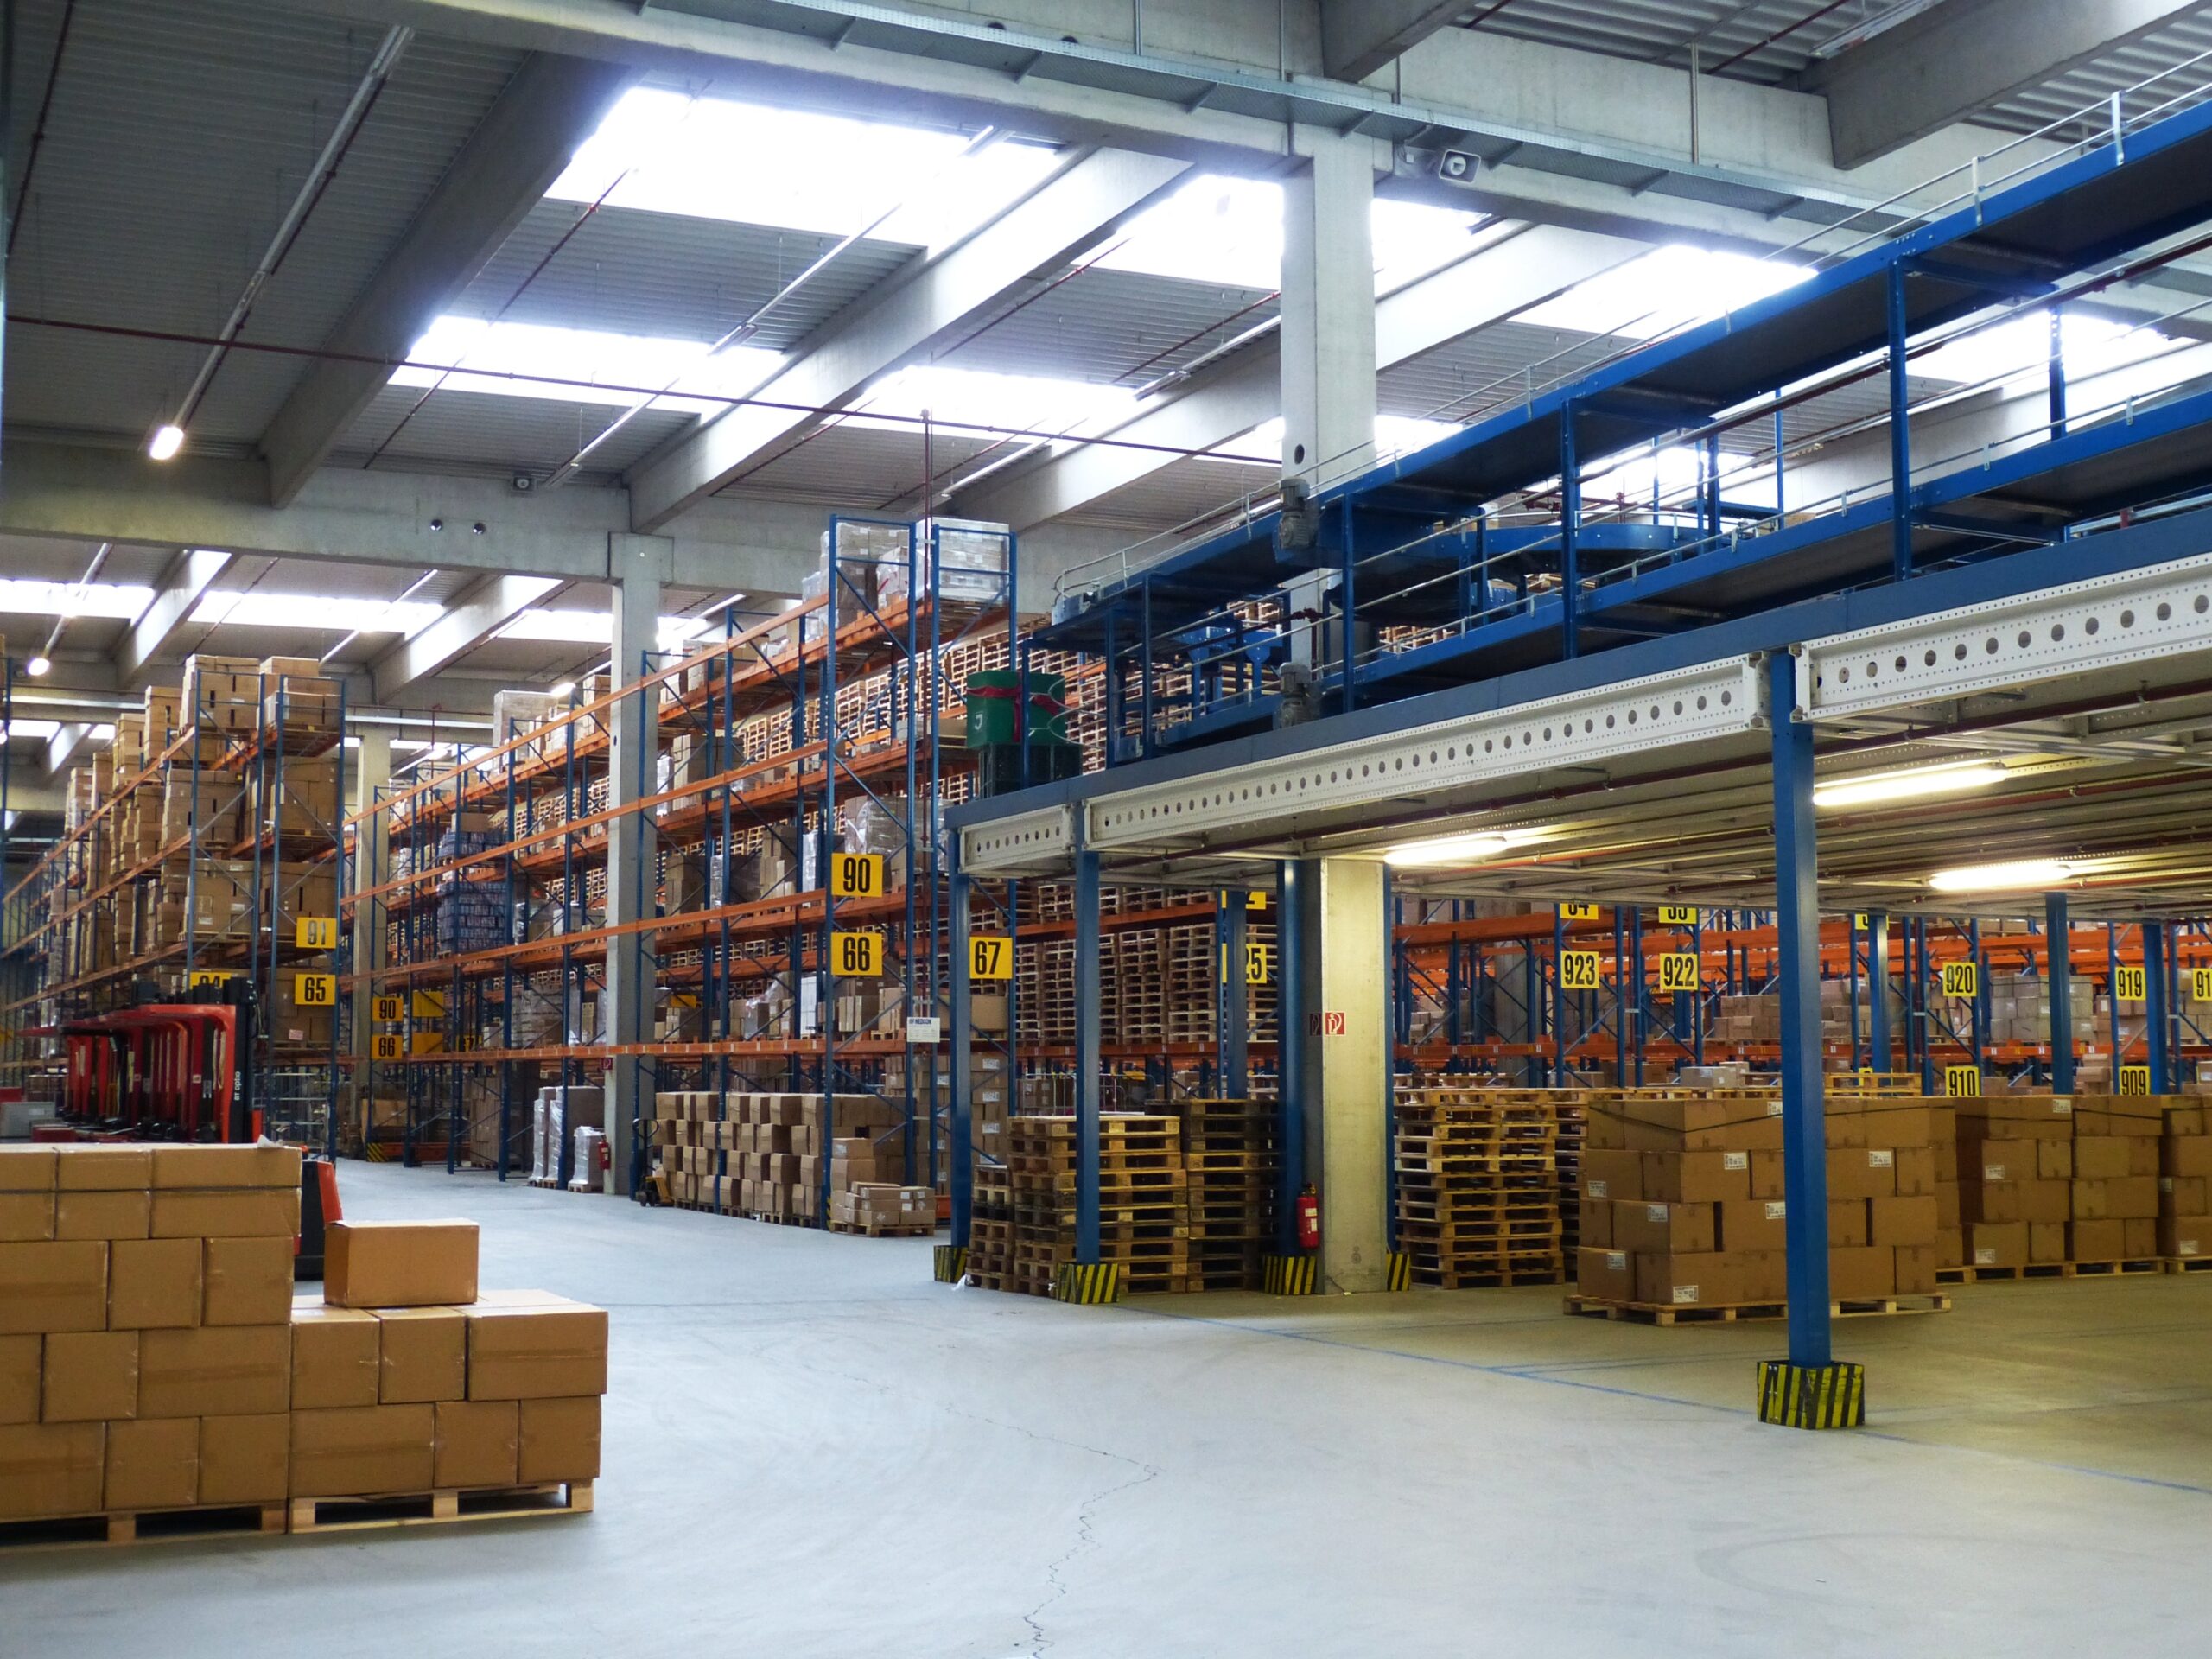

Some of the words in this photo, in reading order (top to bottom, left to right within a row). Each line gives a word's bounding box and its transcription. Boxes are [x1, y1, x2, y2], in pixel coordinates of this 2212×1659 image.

[842, 857, 871, 893] 90
[308, 920, 326, 945] 91
[843, 936, 871, 971] 66
[975, 940, 1001, 975] 67
[1564, 954, 1596, 985] 923
[1663, 956, 1694, 987] 922
[1946, 965, 1973, 993] 920
[2118, 969, 2142, 997] 919
[304, 976, 327, 1002] 65
[379, 999, 396, 1020] 90
[378, 1037, 395, 1057] 66
[1949, 1070, 1975, 1096] 910
[2121, 1070, 2146, 1096] 909
